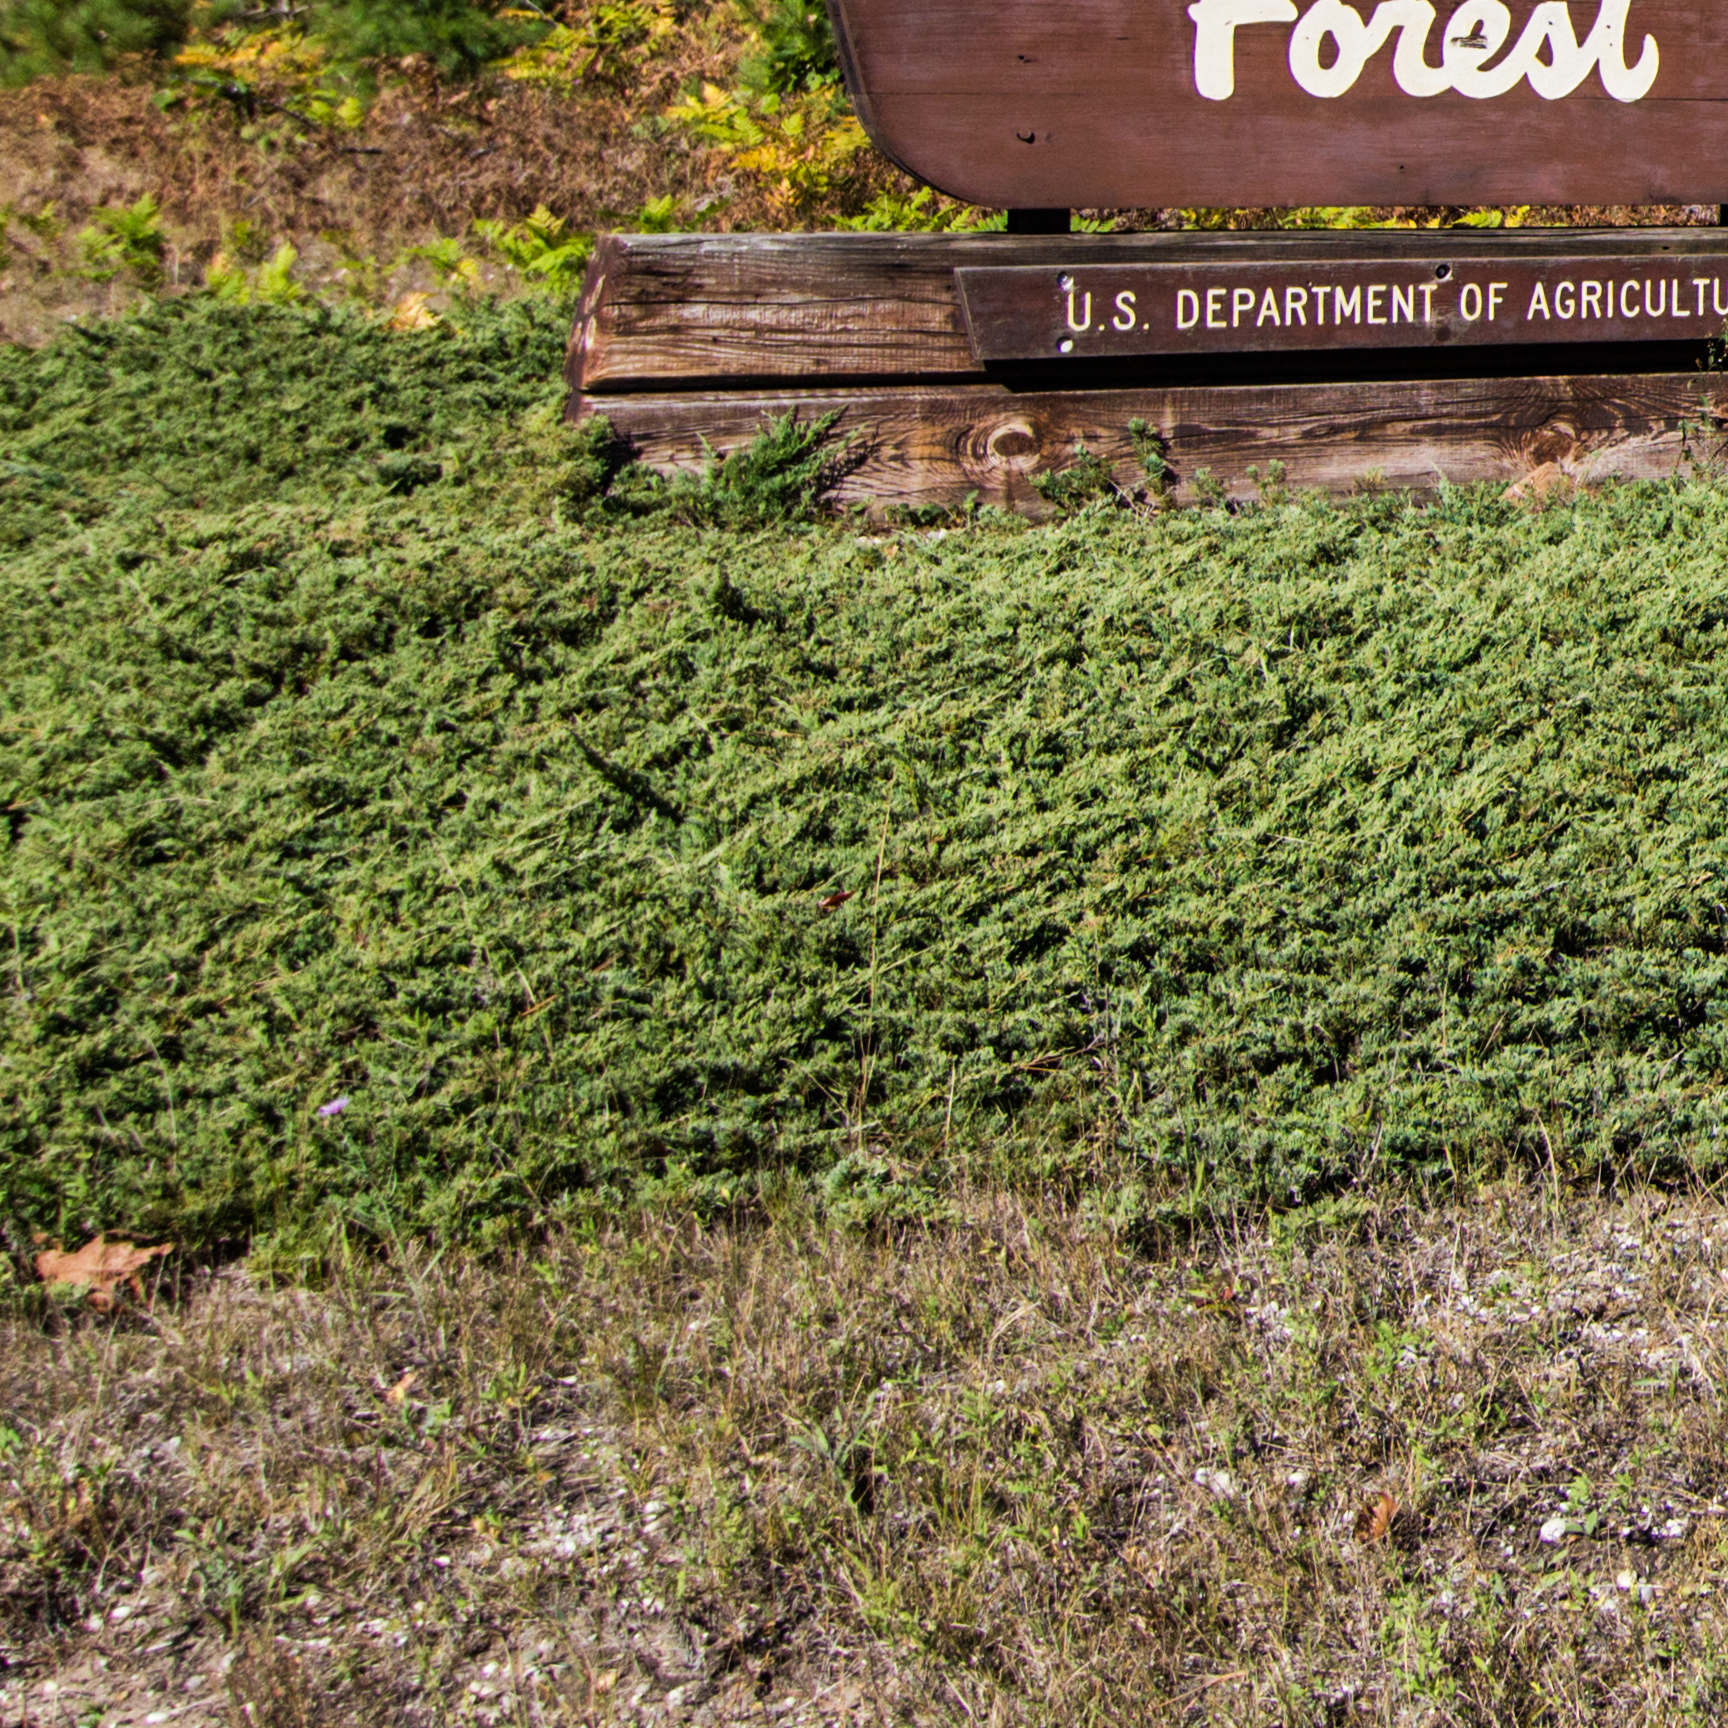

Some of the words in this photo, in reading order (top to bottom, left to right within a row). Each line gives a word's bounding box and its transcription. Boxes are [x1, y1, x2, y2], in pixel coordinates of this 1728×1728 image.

[1066, 289, 1150, 332] U.S.
[1176, 282, 1436, 329] DEPARTMENT
[1459, 282, 1505, 321] OF
